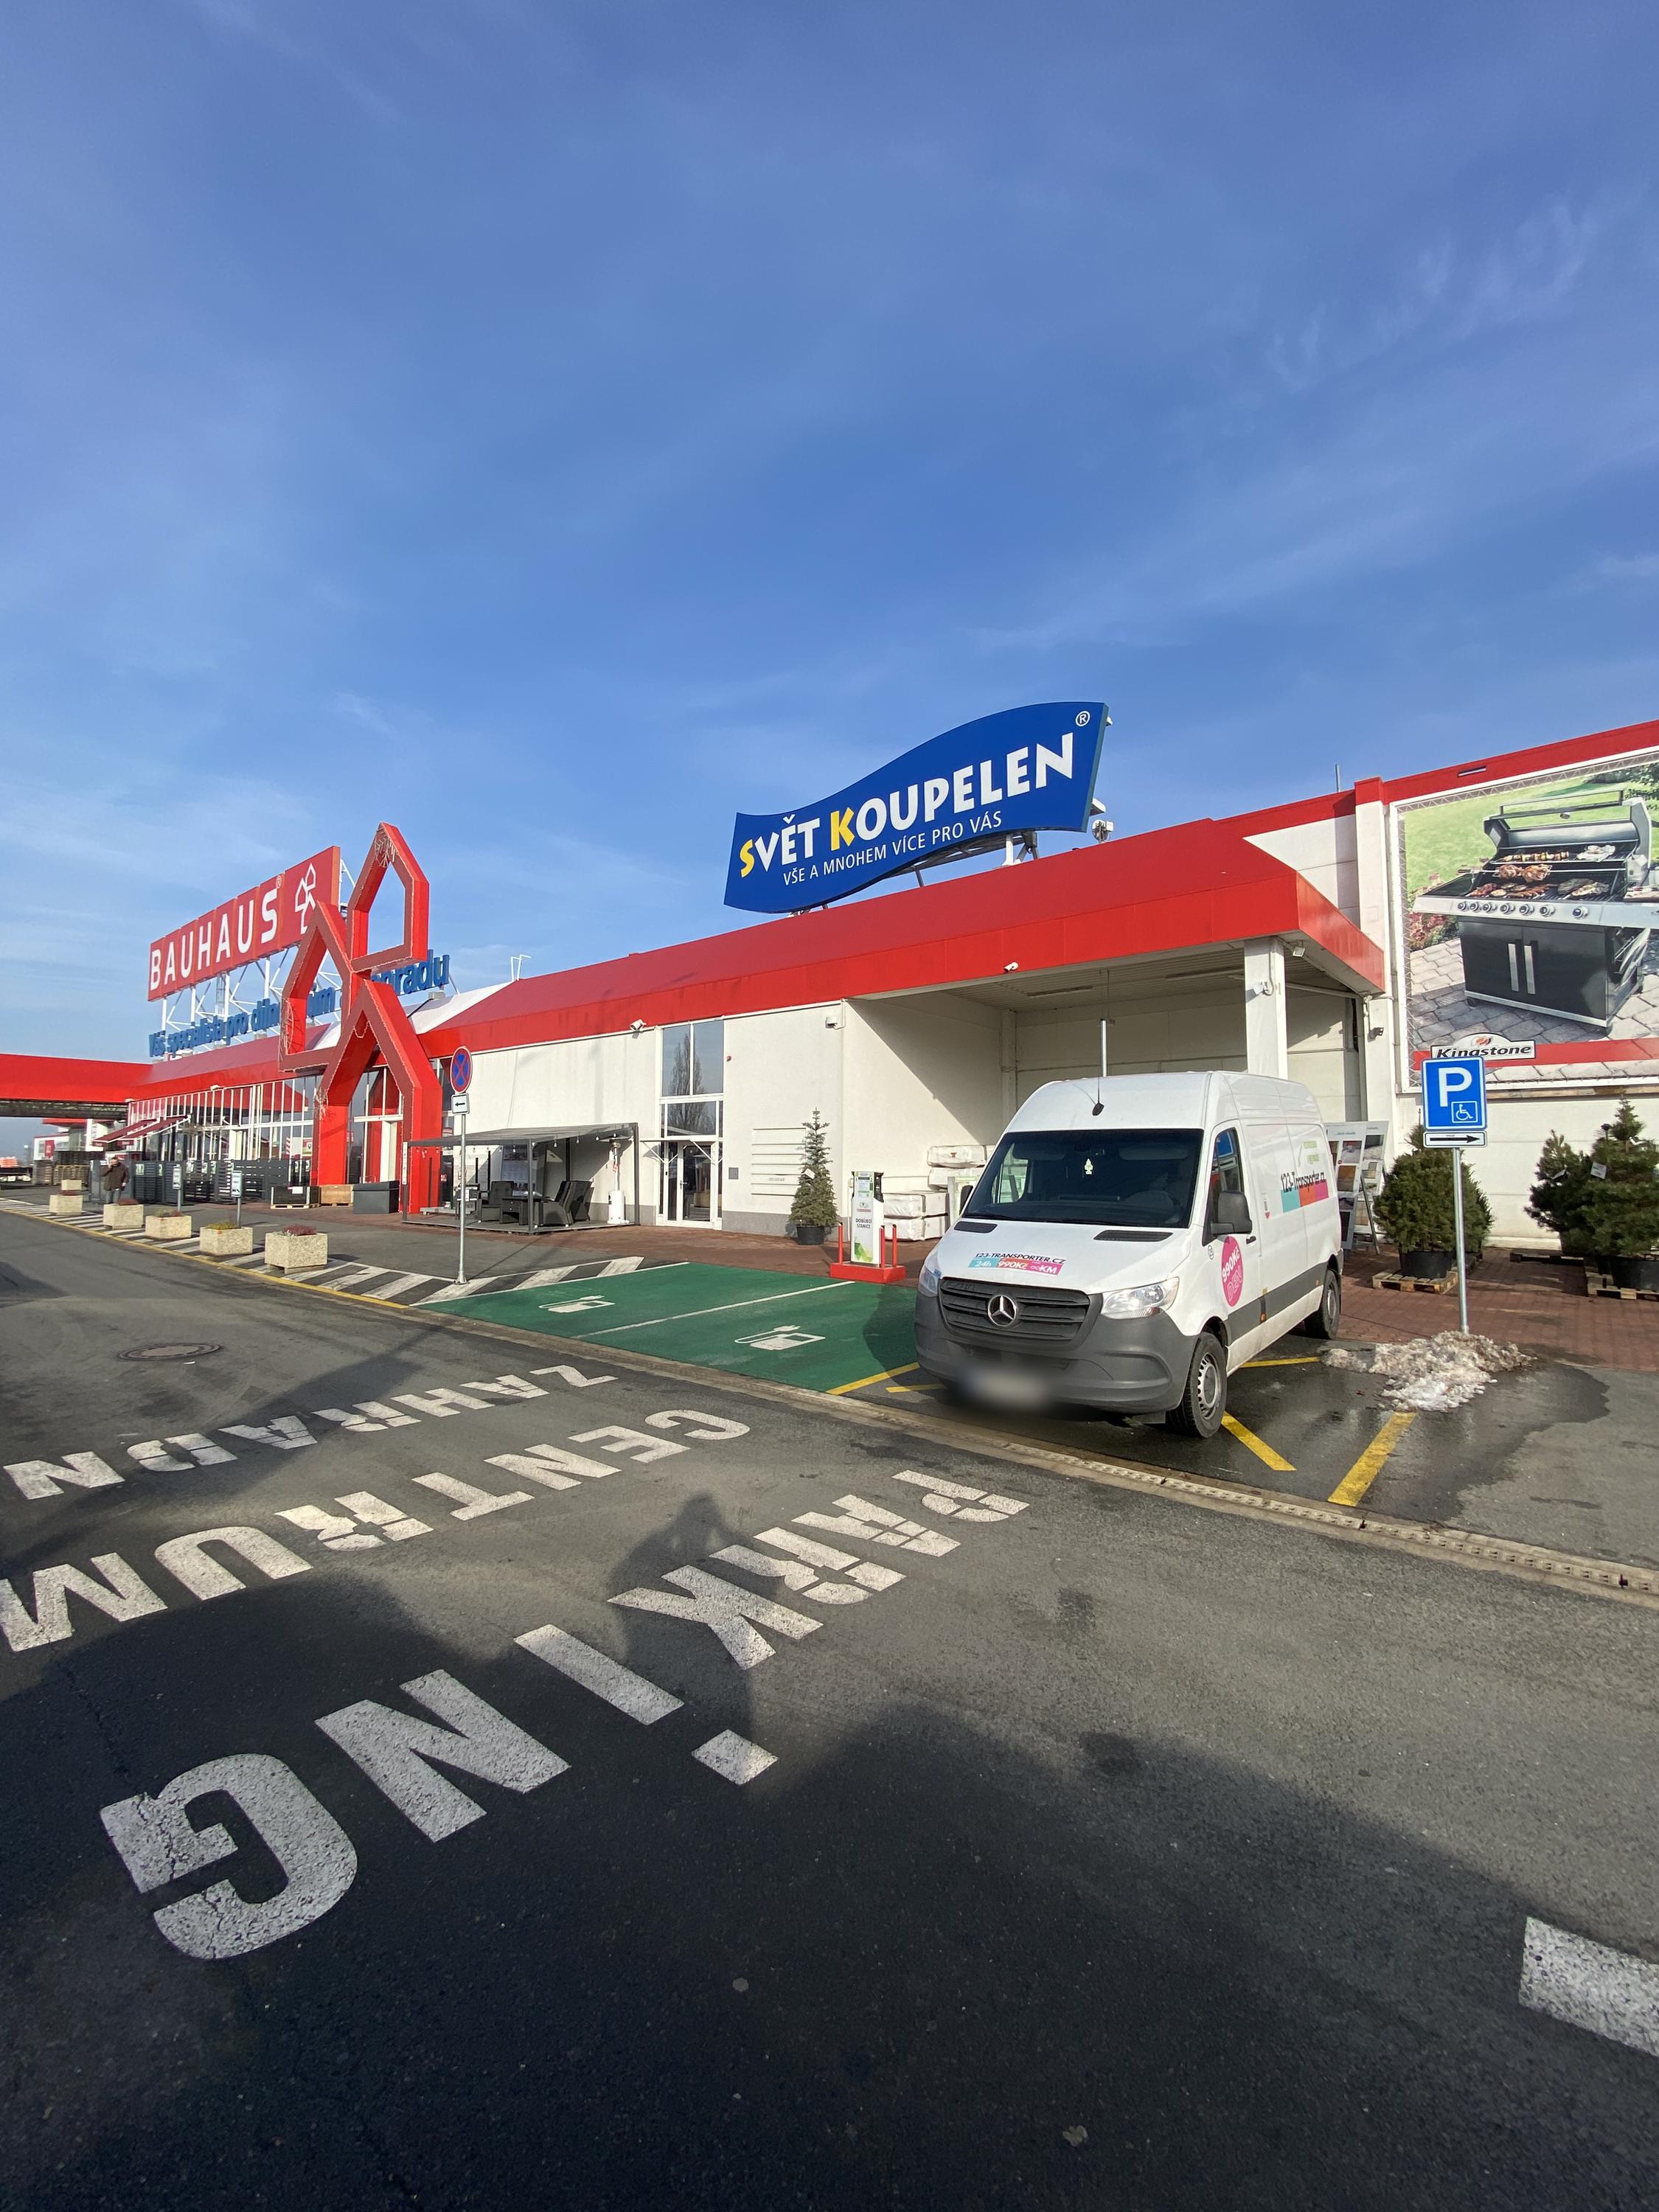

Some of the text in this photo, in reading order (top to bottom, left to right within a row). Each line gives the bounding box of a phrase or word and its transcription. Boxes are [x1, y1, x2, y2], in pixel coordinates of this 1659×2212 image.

[740, 732, 1074, 877] SVĚT KOUPELEN
[783, 810, 1003, 886] VŠE A MNOHEM VÍCE PRO VÁS
[150, 888, 278, 991] BAUHAUS
[1438, 1067, 1472, 1107] P
[975, 1253, 1067, 1264] 123-TRANSPORTER.CZ
[0, 1409, 751, 1652] CENTRUM
